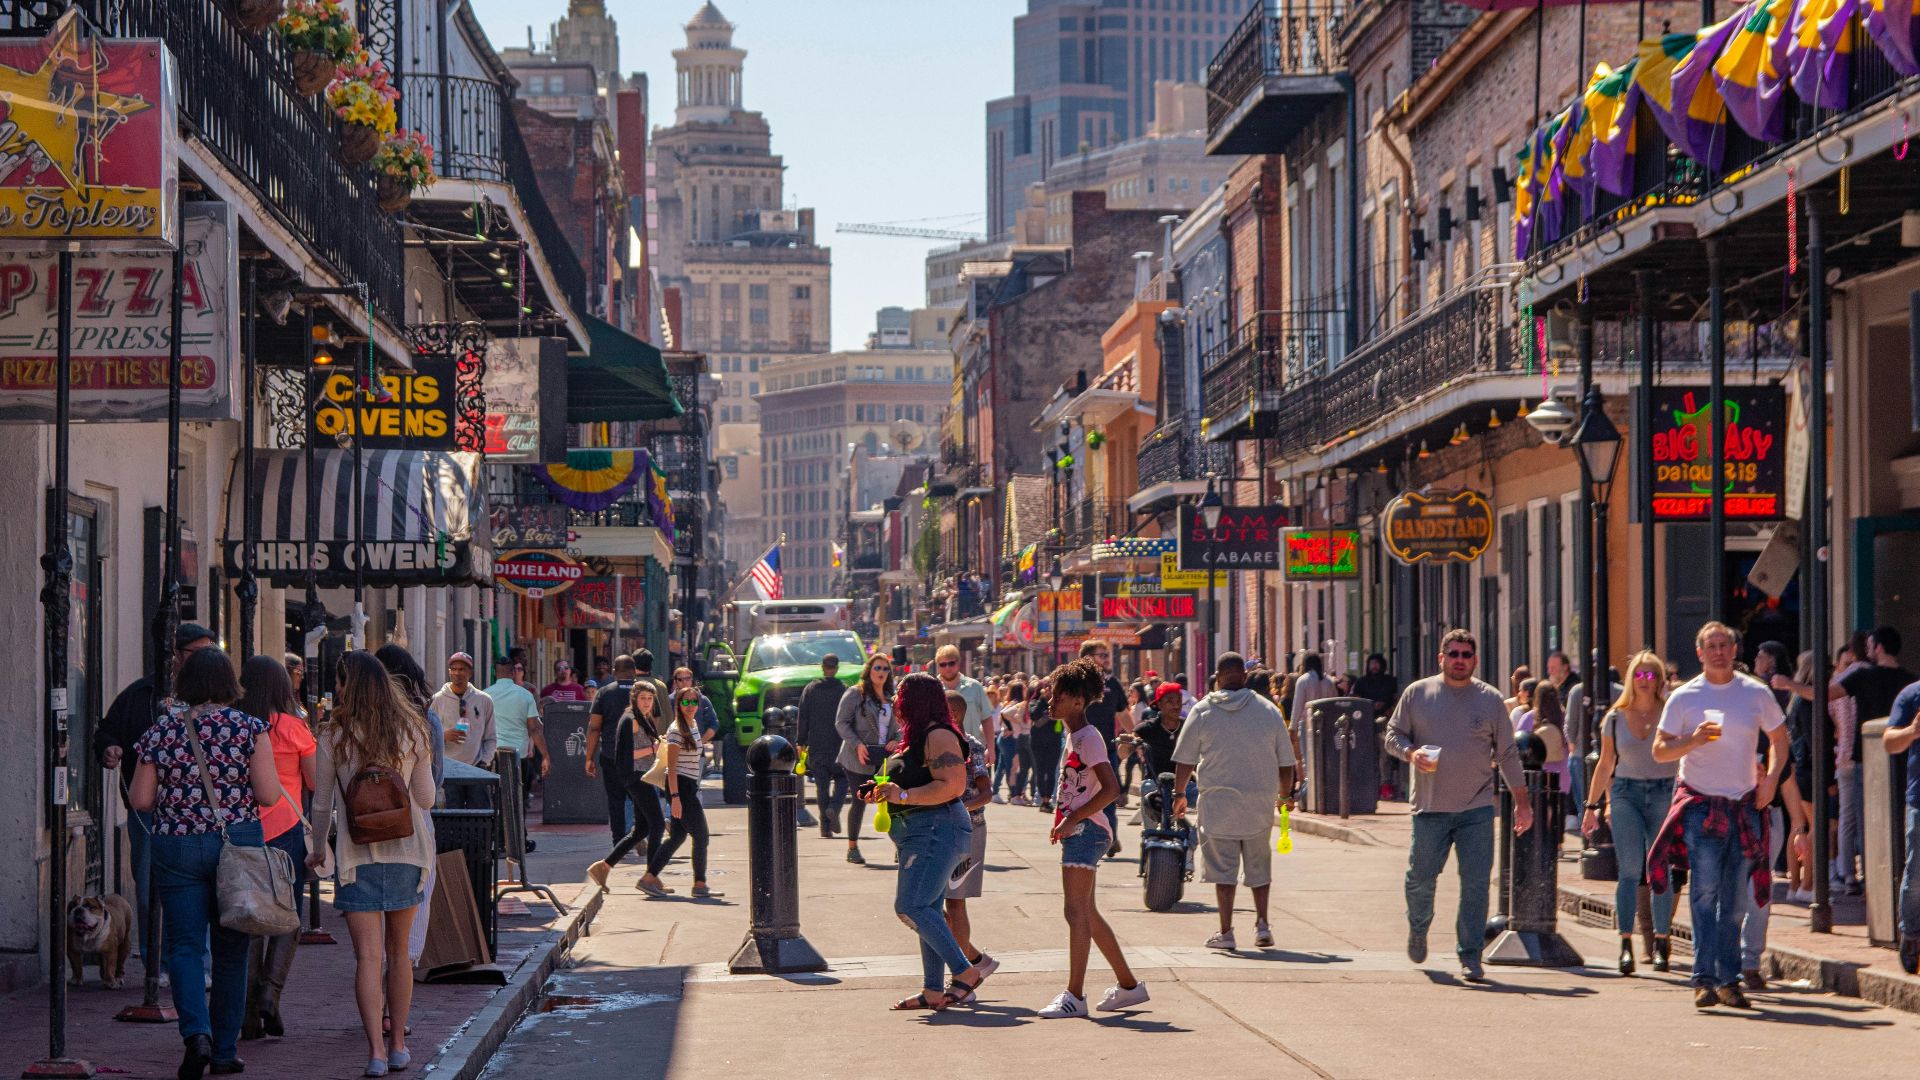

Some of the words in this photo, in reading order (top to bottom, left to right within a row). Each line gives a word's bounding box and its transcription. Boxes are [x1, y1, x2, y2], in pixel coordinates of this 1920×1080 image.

[23, 194, 155, 234] Topless
[0, 258, 213, 319] PIZZA
[32, 326, 172, 350] EXPRESS
[2, 359, 58, 386] PIZZA
[69, 359, 95, 386] BY
[100, 358, 142, 385] THE
[149, 357, 207, 386] SLCE
[316, 407, 448, 437] OWENS
[1653, 424, 1698, 461] BIG
[1708, 422, 1773, 461] ASY
[1192, 528, 1280, 542] SUTR
[1394, 518, 1488, 539] BANDSTAND
[234, 543, 330, 570] CHRIS
[343, 542, 457, 570] OWENS
[494, 563, 581, 579] DIXIELAND
[528, 588, 543, 597] ATM
[573, 585, 646, 605] SEAFOD
[1103, 597, 1138, 618] BARELY
[1141, 596, 1168, 618] LEGAL
[1171, 595, 1195, 617] CLUB
[951, 857, 971, 880] NIKE
